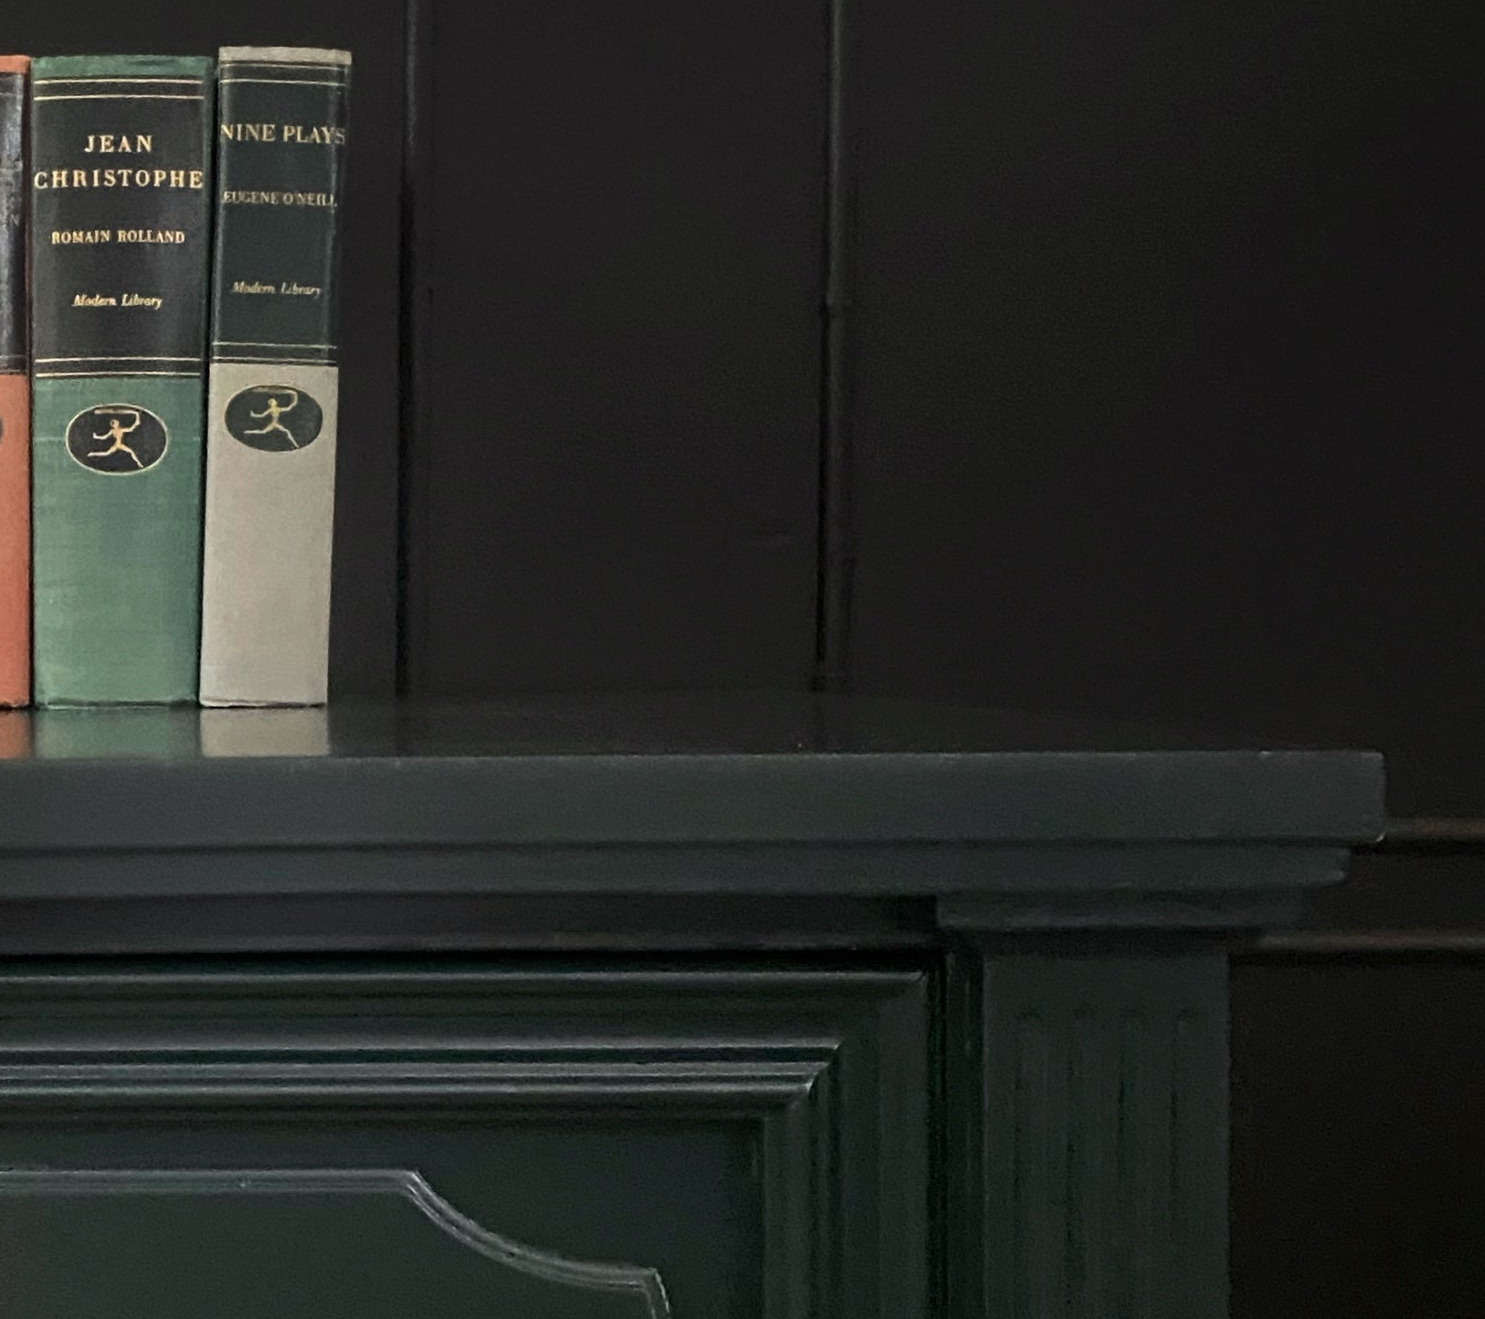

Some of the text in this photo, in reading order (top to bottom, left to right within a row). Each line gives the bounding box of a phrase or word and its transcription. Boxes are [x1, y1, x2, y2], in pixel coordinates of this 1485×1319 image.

[221, 123, 346, 144] NINE PLAYS
[84, 134, 153, 153] JEAN
[34, 169, 203, 189] CHRISTOPHE
[223, 191, 277, 205] EUGENE
[51, 230, 185, 244] ROMAIN ROLLAND
[231, 281, 322, 299] Modern Library
[71, 293, 163, 310] Modern Library
